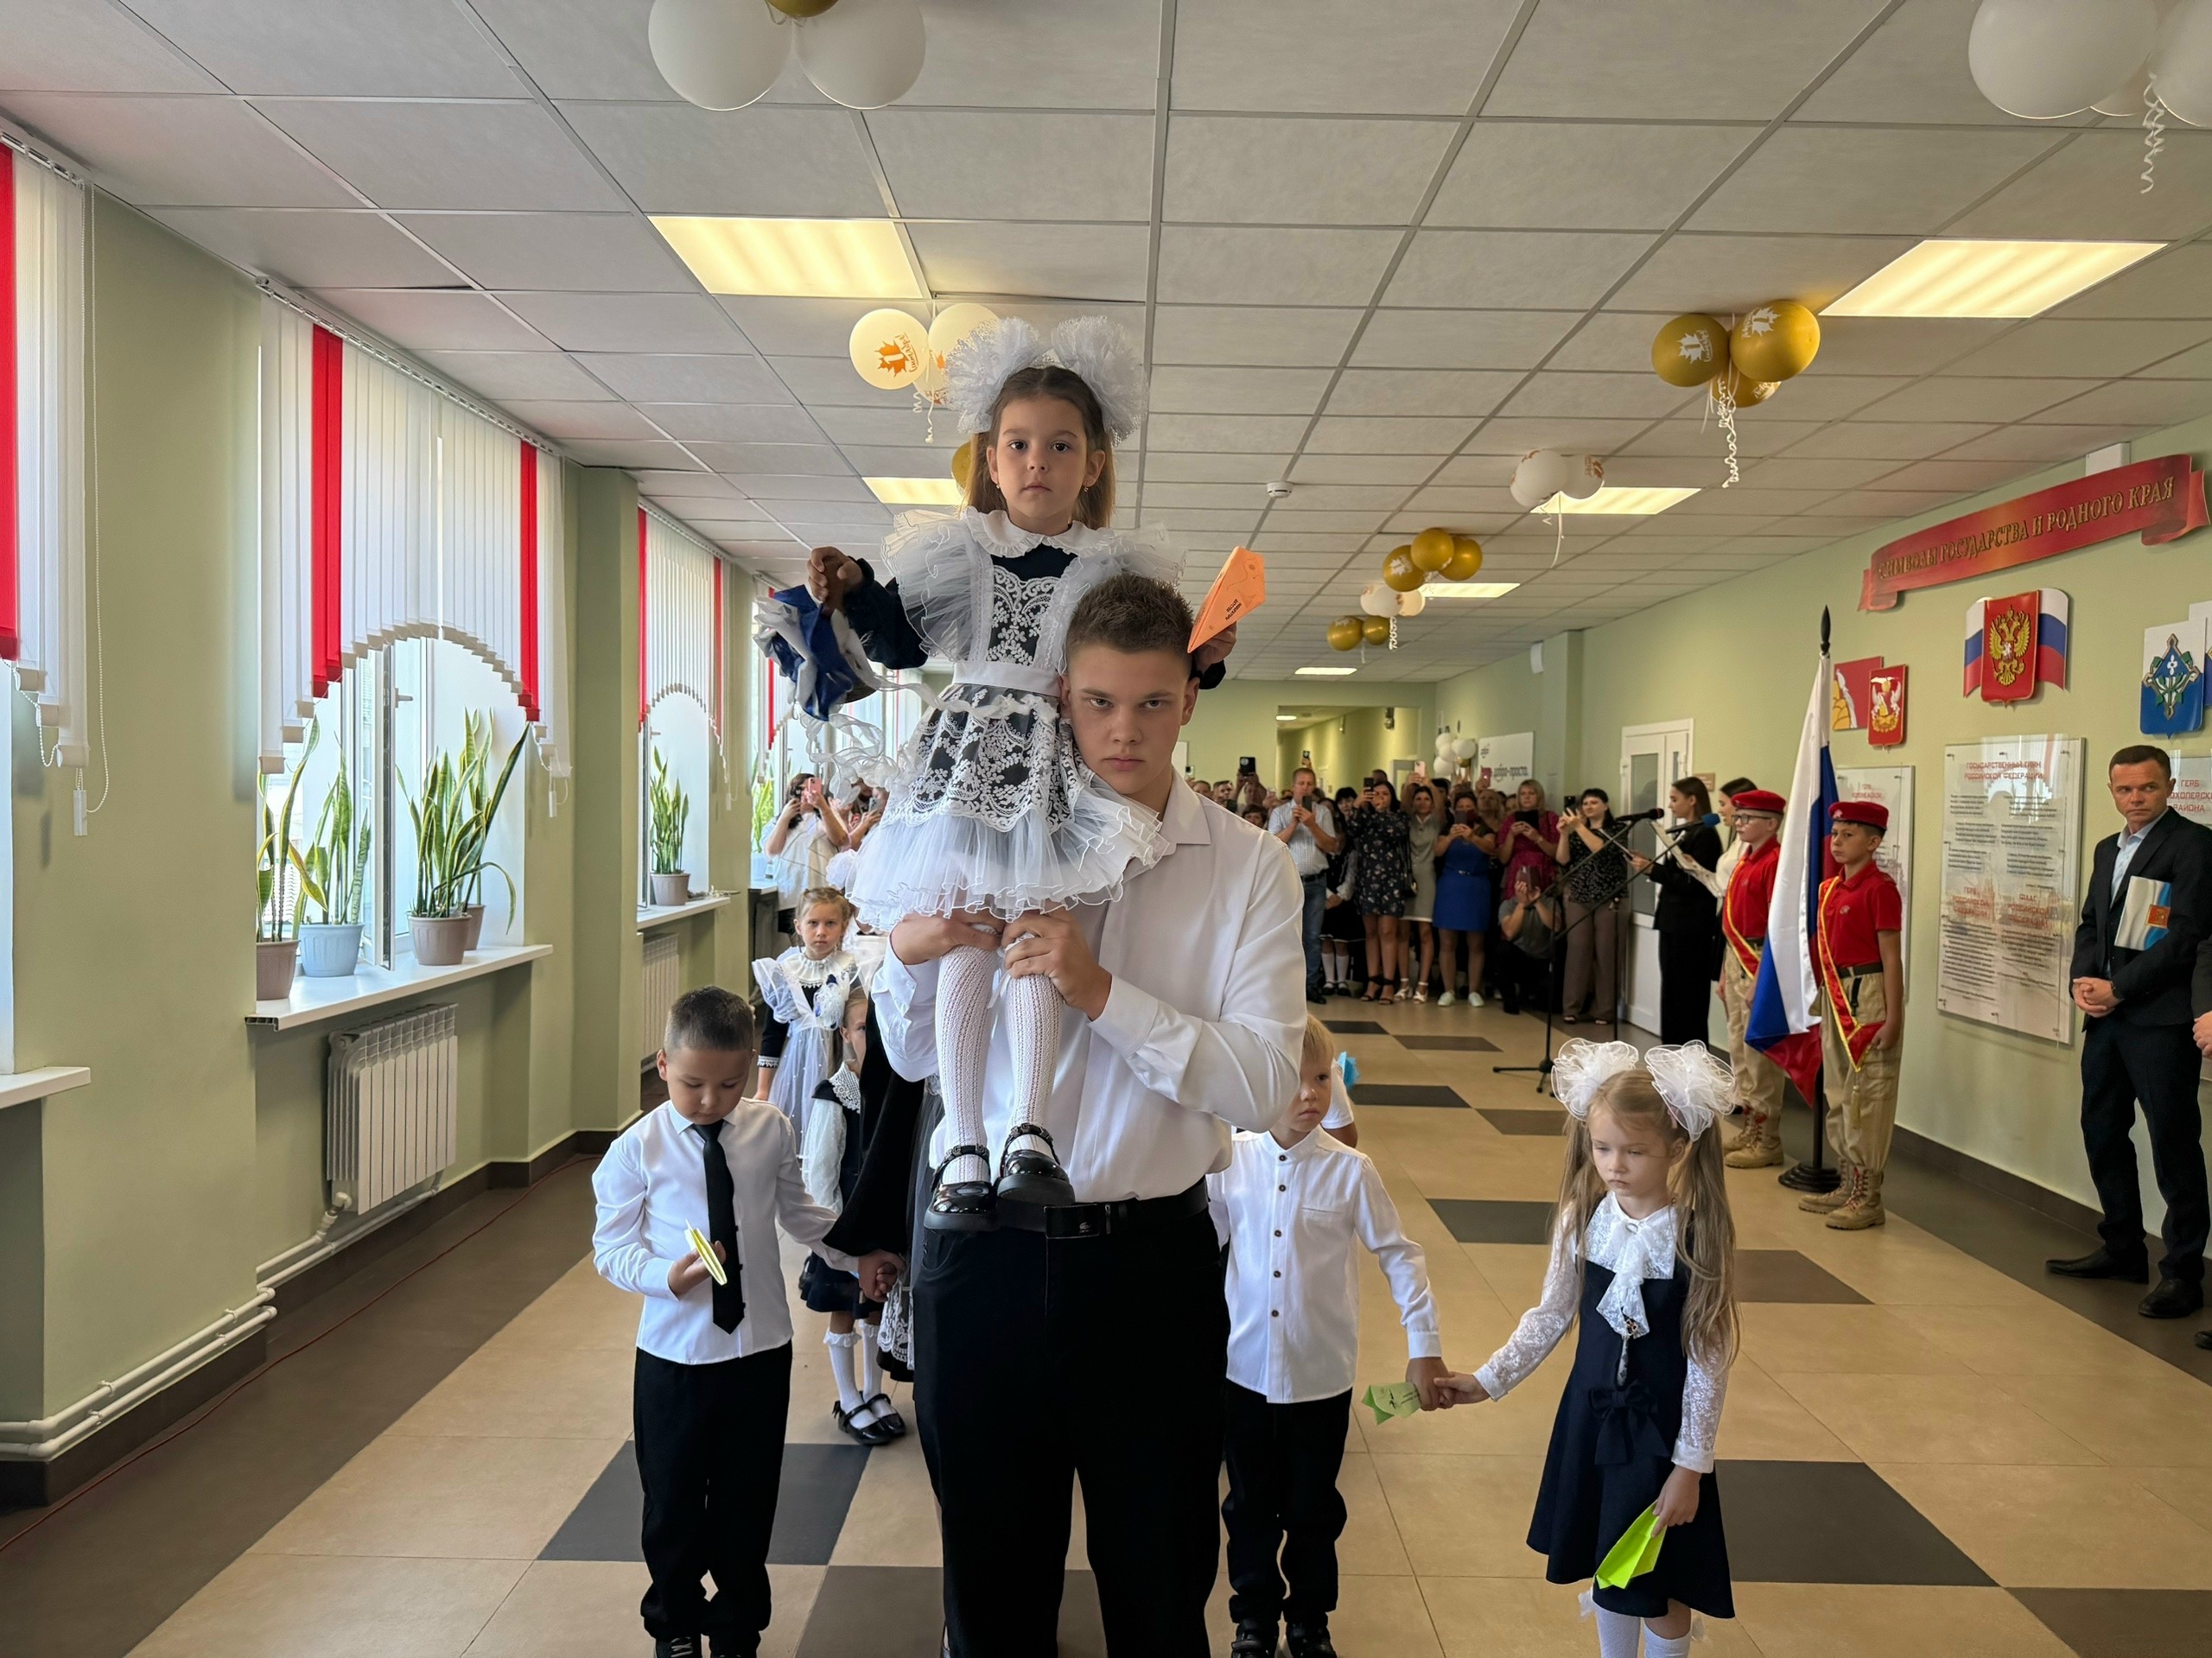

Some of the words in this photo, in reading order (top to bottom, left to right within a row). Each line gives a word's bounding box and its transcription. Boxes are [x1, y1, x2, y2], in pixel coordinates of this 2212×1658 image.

[1878, 546, 1938, 580] СИМВОЛЫ
[1940, 520, 2029, 562] ГОСУДАРСТВА
[2032, 516, 2044, 537] И
[2047, 492, 2124, 532] РОДНОГО
[2128, 476, 2175, 510] КРАЯ
[2180, 779, 2200, 788] ГЕРБ
[2169, 791, 2212, 800] ОХОПЕРСК
[2173, 804, 2205, 812] РАЙОНА
